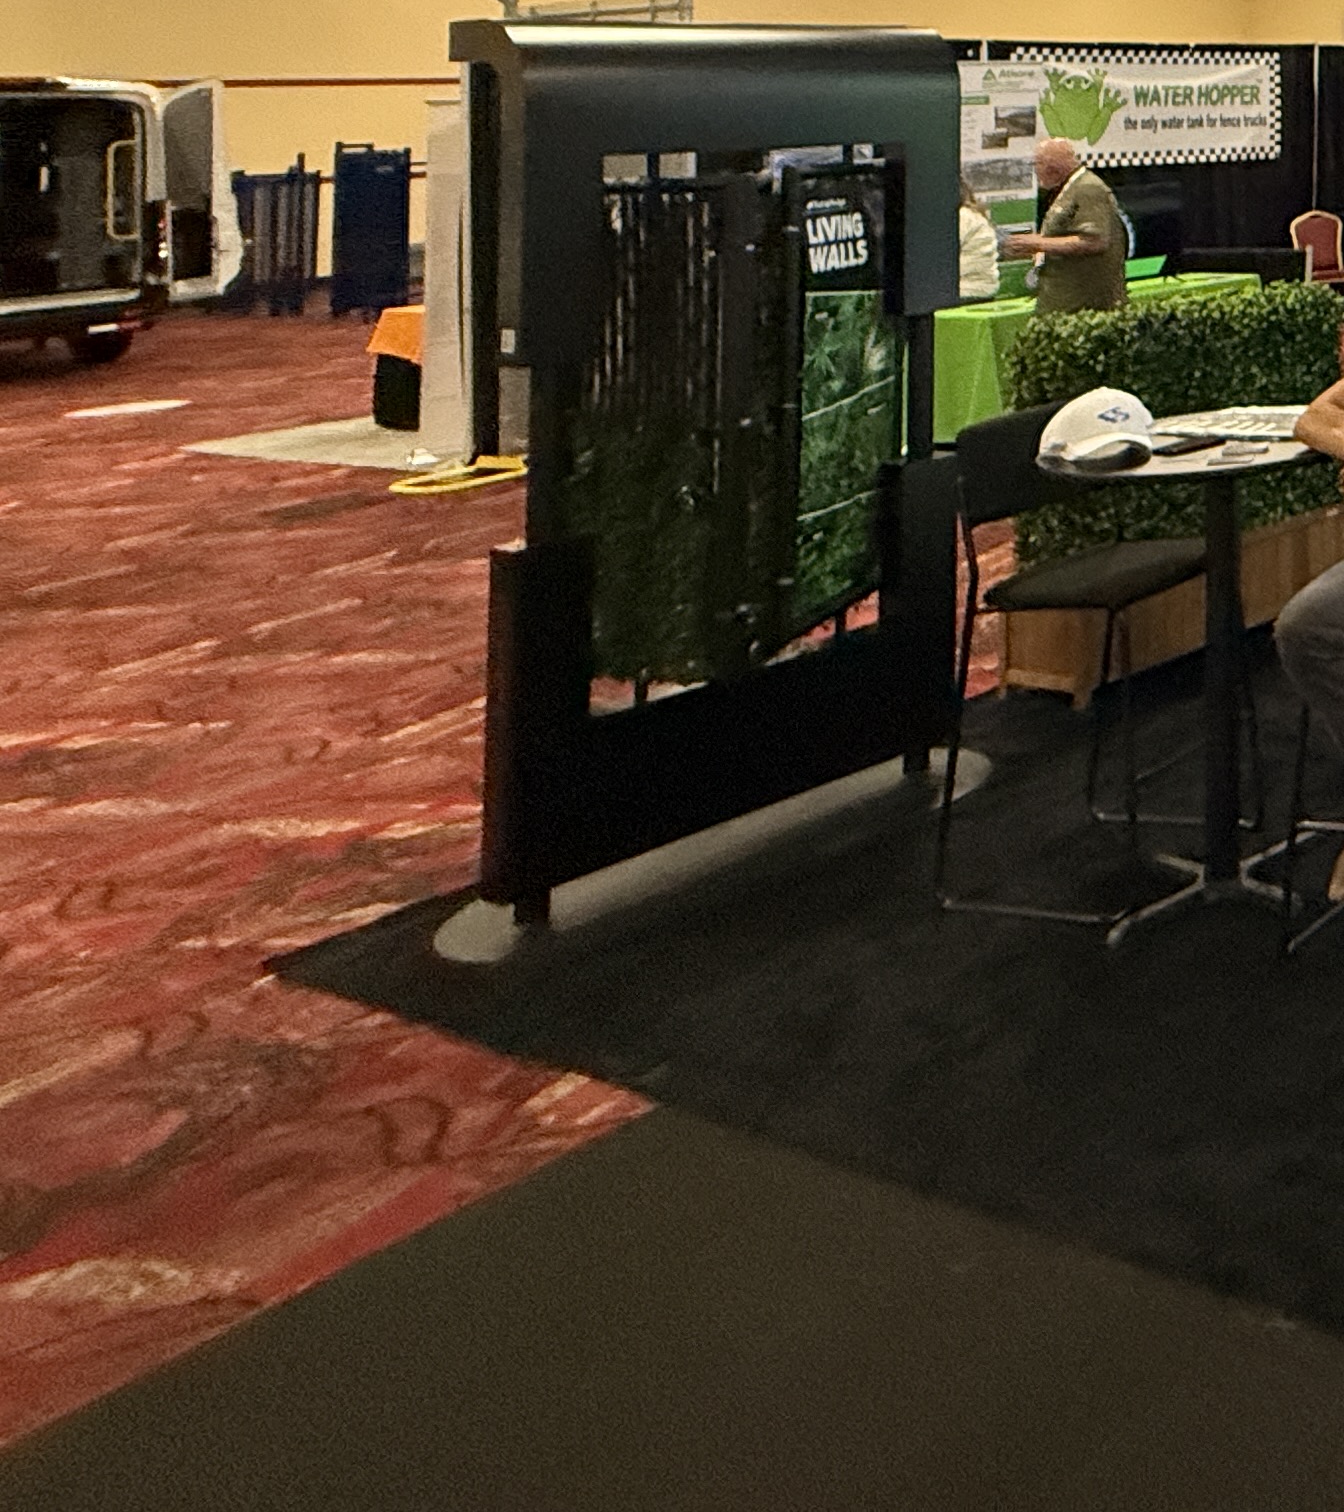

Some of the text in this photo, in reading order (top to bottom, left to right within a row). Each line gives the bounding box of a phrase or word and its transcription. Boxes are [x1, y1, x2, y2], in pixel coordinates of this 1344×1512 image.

[1133, 83, 1261, 107] WATER HOPPER
[1124, 116, 1138, 130] the
[1141, 115, 1158, 133] only
[1161, 114, 1185, 129] water
[1187, 114, 1204, 128] tank
[1243, 112, 1268, 127] trucks
[806, 211, 865, 245] LIVING
[808, 239, 869, 274] WALLS
